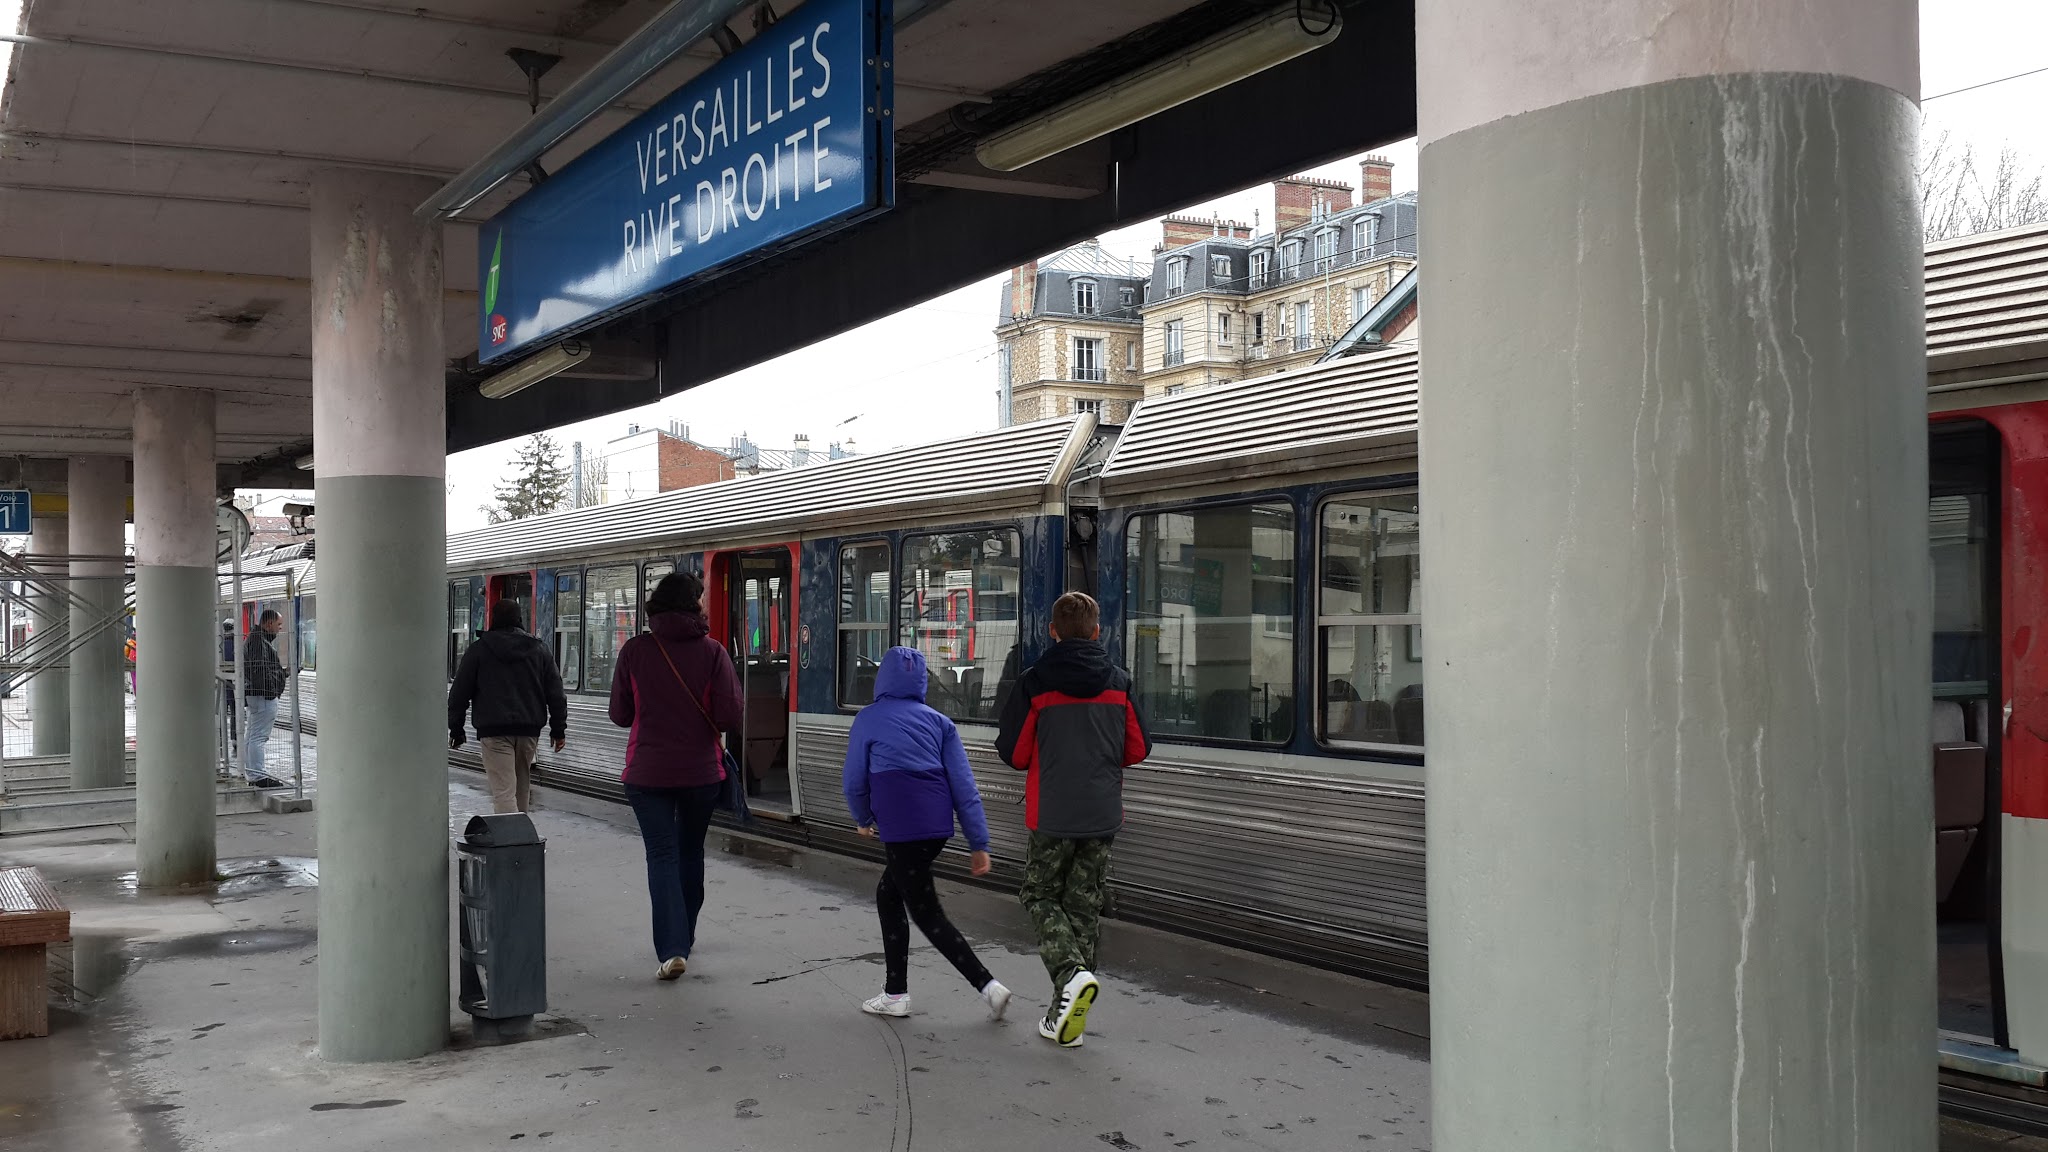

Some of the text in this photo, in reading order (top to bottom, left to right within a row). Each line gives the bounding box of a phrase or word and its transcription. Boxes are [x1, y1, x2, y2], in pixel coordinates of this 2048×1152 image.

[636, 22, 831, 194] VERSAILLES
[623, 116, 832, 277] RIVE DROITE
[492, 323, 507, 342] SNCF
[0, 506, 10, 529] 1
